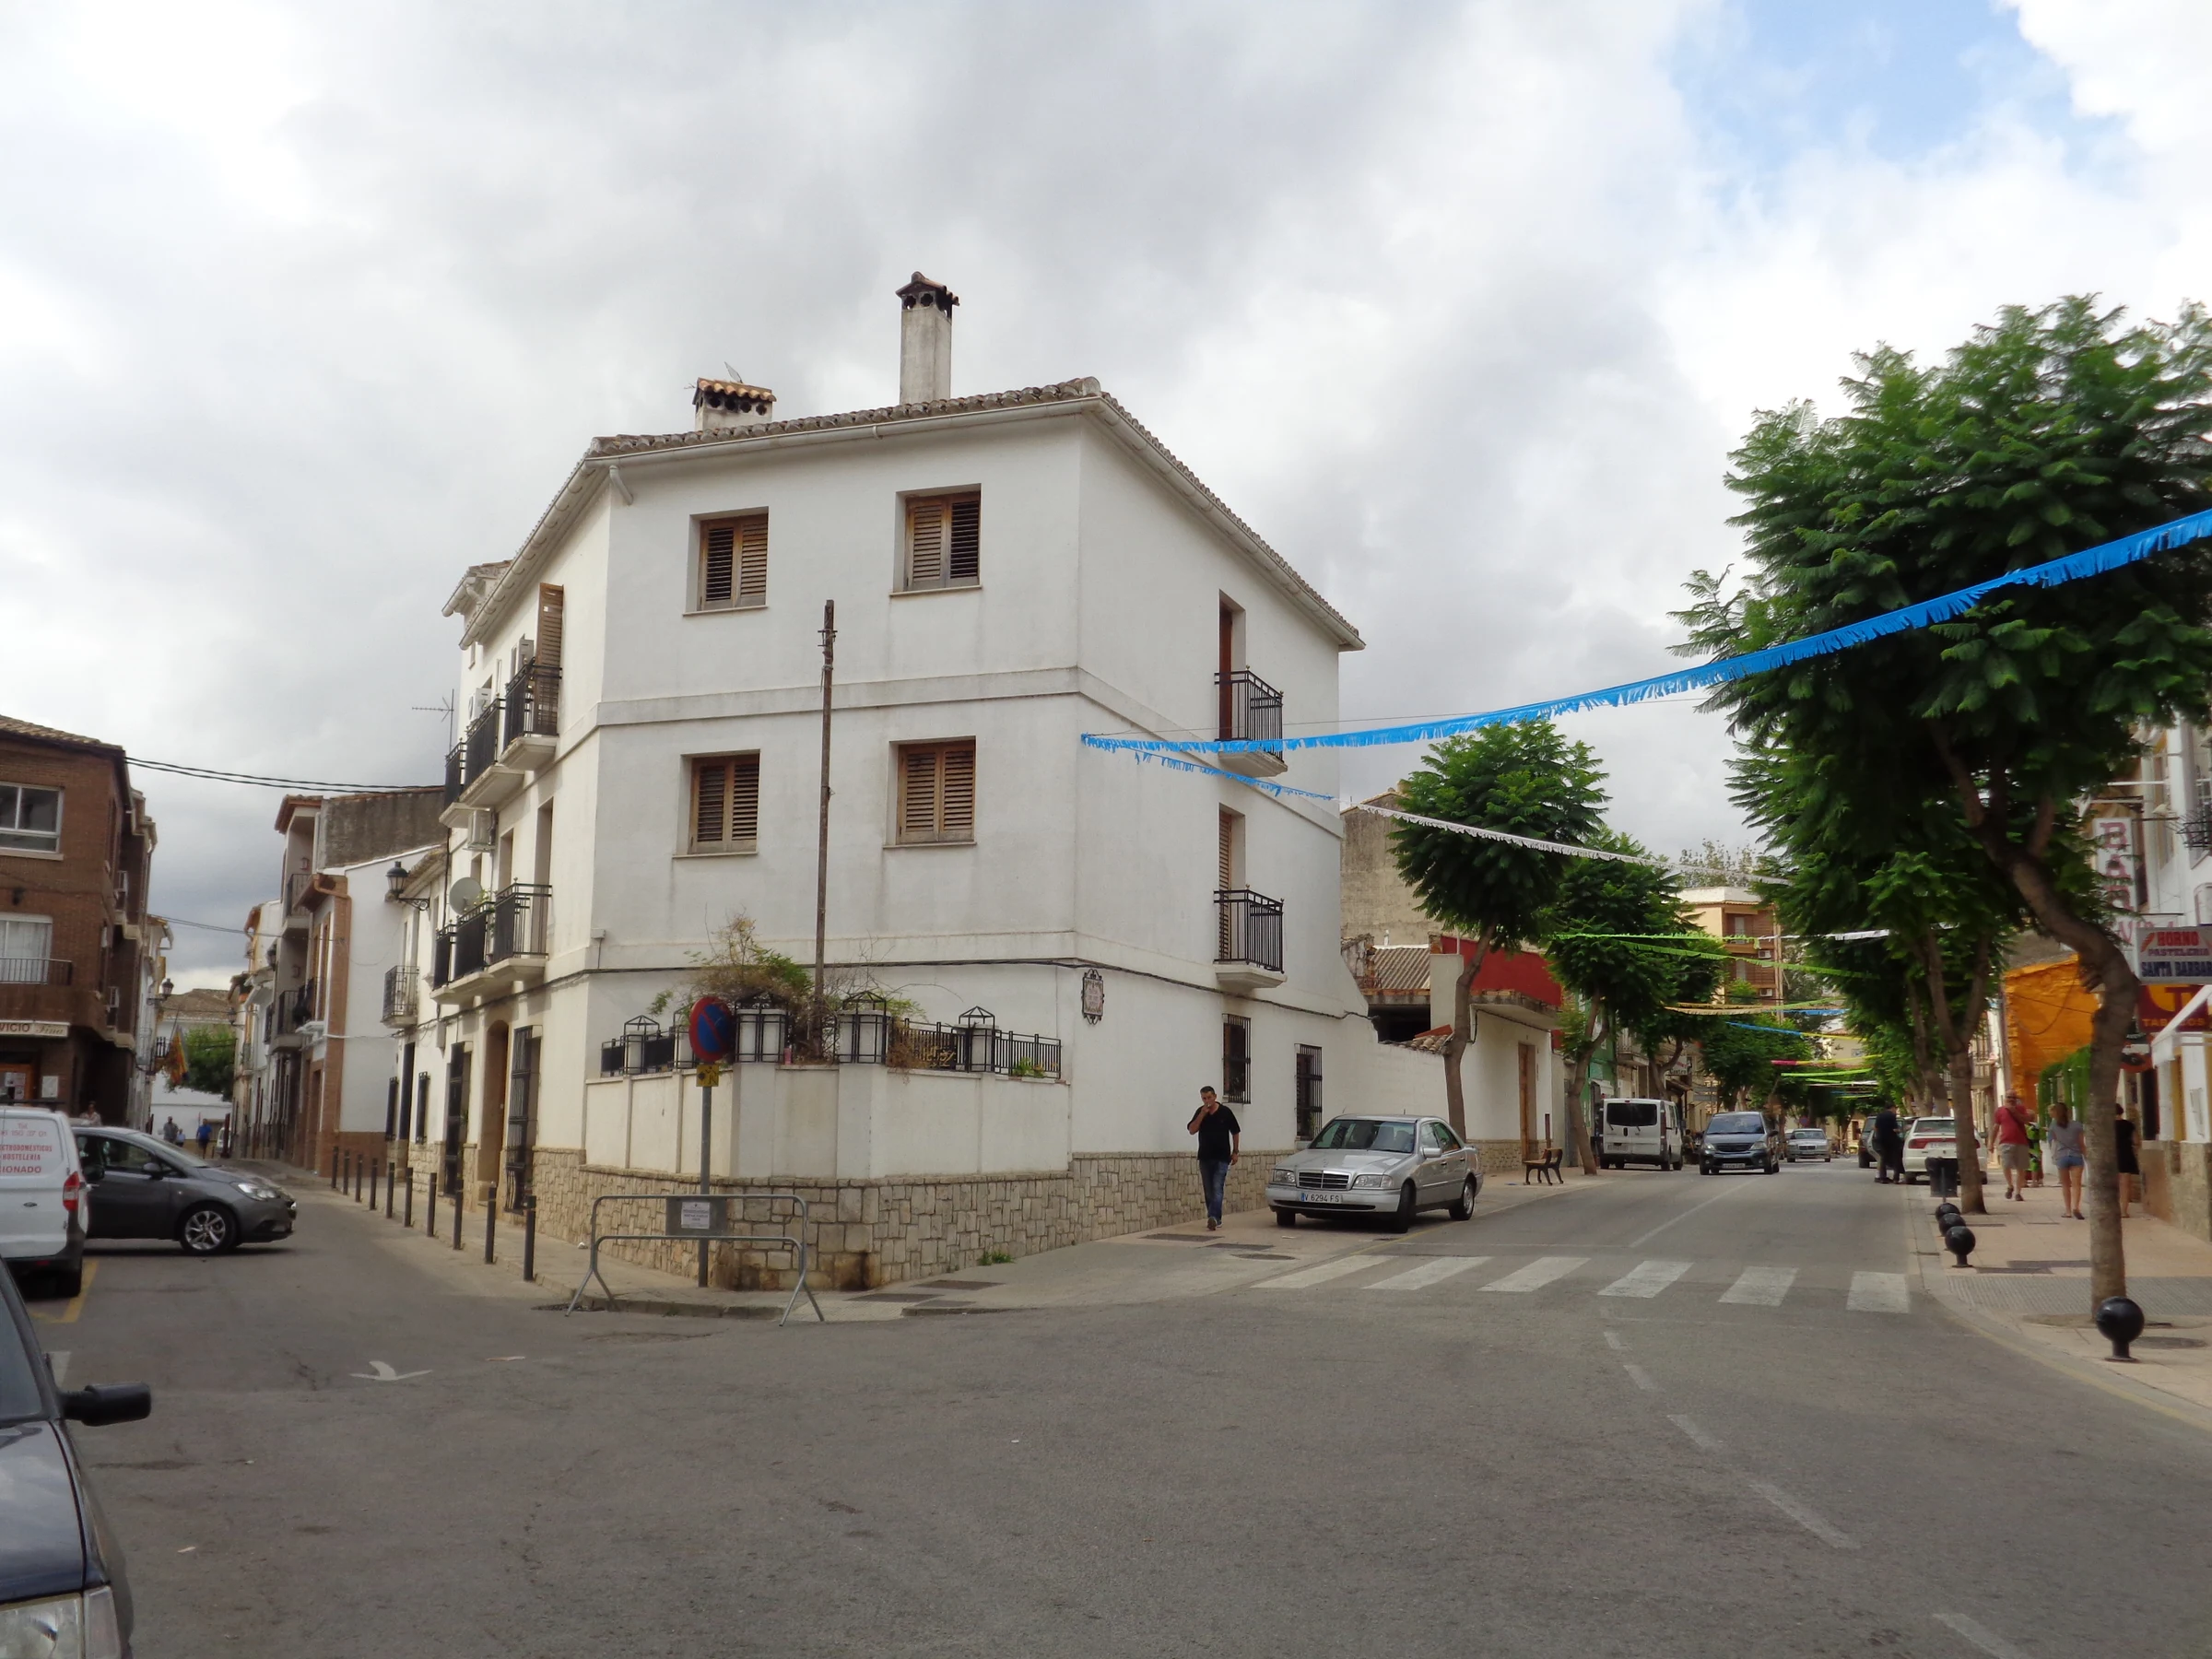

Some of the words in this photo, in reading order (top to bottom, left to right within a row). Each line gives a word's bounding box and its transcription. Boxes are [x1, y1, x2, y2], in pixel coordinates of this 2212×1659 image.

[2157, 931, 2199, 947] HORNO
[2142, 961, 2172, 977] SANTA
[1311, 1194, 1328, 1202] 6294
[1330, 1194, 1339, 1203] FS
